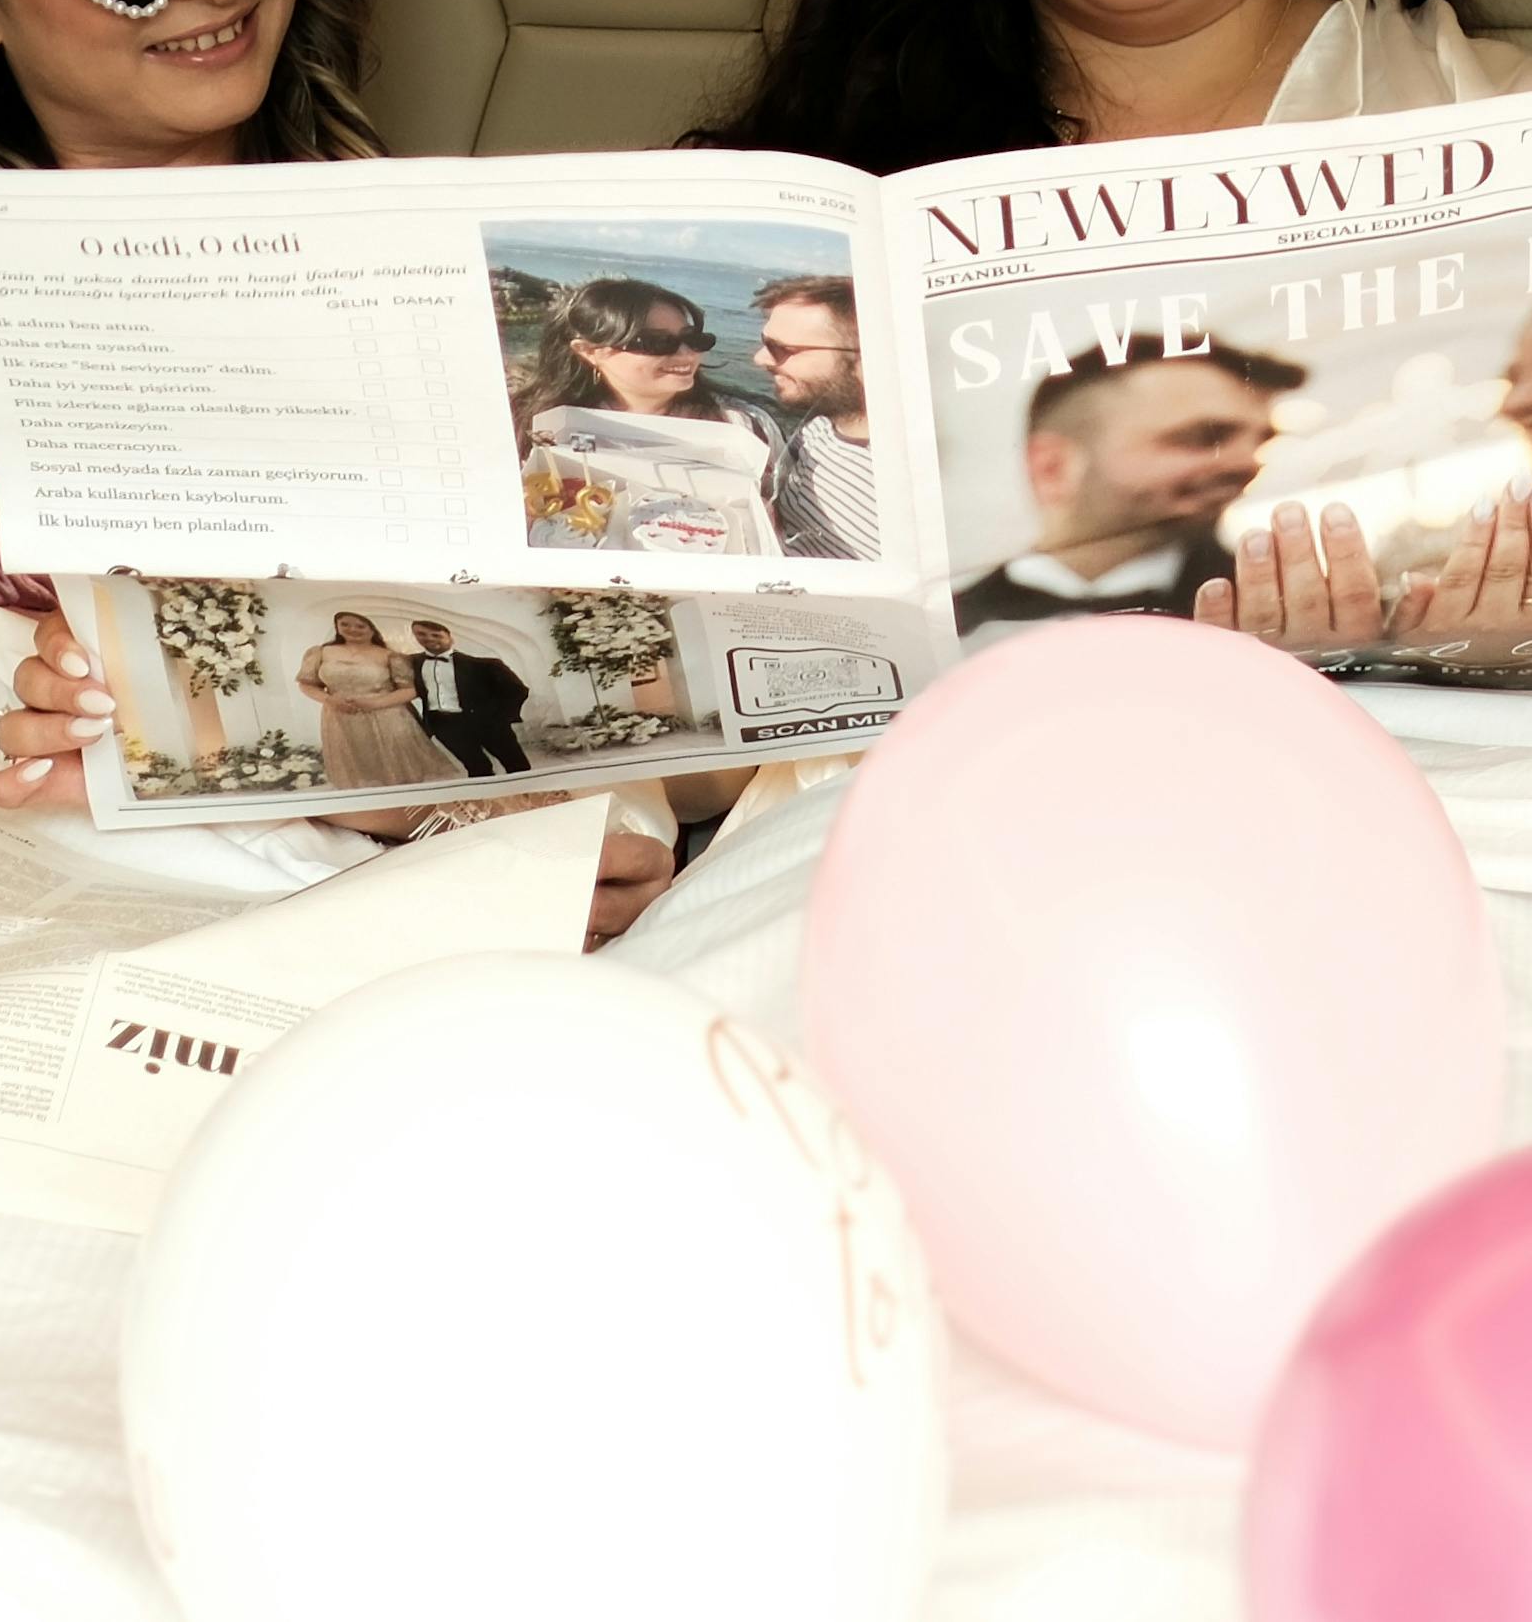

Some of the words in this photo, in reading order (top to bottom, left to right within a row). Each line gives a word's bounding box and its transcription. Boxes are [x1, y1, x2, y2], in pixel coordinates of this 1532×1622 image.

[778, 190, 816, 205] Ekim
[924, 138, 1497, 264] NEWLYWED
[80, 235, 103, 257] O
[113, 234, 193, 259] dedi,
[199, 234, 224, 257] O
[232, 232, 301, 255] dedi
[925, 261, 1036, 290] İSTANBUL
[1277, 223, 1362, 246] SPECIAL
[1365, 207, 1463, 234] EDITION
[247, 269, 298, 286] hangi
[393, 294, 457, 307] DAMAT
[950, 292, 1212, 393] SAVE
[1273, 253, 1466, 343] THE
[8, 377, 52, 389] Daha
[80, 382, 134, 393] yemek
[20, 418, 63, 429] Daha
[26, 438, 69, 451] Daha
[30, 460, 82, 476] Sosyal
[86, 462, 160, 478] medyada
[164, 463, 202, 478] fazla
[207, 469, 261, 479] zaman
[265, 468, 369, 484] geçiriyorum.
[35, 486, 83, 500] Araba
[88, 487, 181, 503] kullanırken
[185, 491, 289, 507] kaybolurum.
[38, 512, 61, 528] İlk
[64, 515, 149, 532] buluşmayı
[153, 517, 183, 532] ben
[187, 518, 276, 535] planladım.
[757, 718, 838, 739] SCAN
[847, 712, 891, 728] ME
